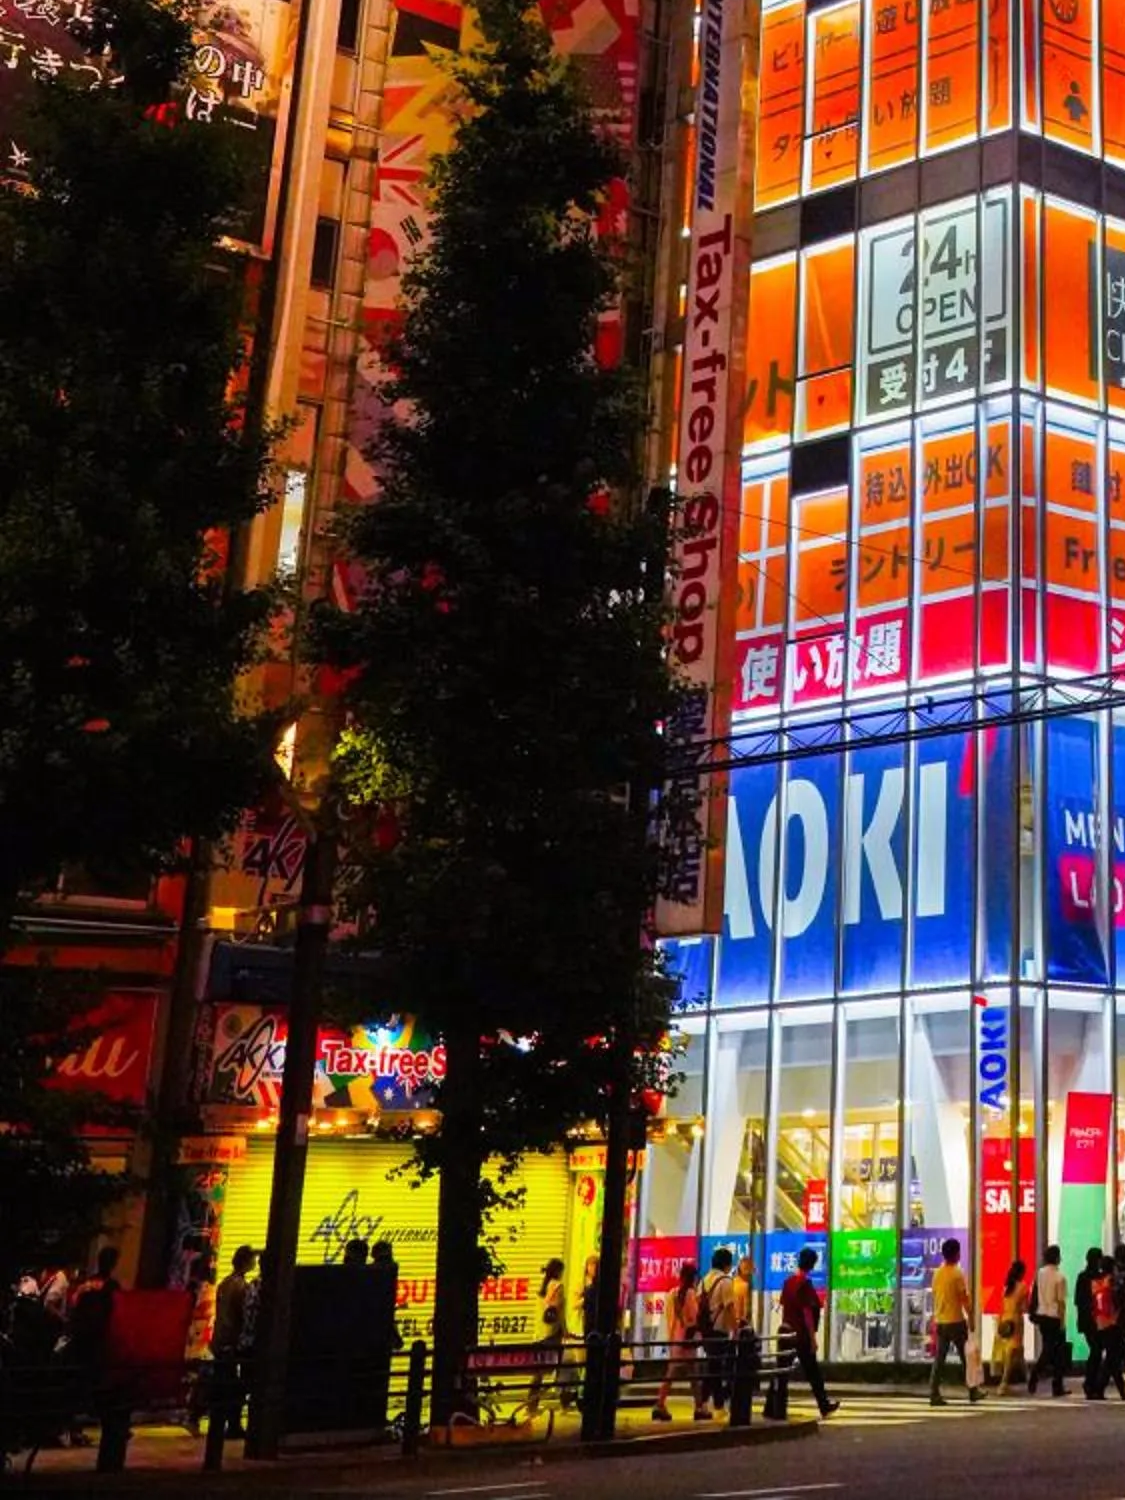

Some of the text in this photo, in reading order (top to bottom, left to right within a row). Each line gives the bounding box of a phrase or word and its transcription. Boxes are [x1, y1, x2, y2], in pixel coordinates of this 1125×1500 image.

[687, 211, 732, 485] Tax-free
[675, 492, 720, 666] Shop
[321, 1039, 431, 1078] Tax-free
[979, 1006, 1008, 1112] AOKI
